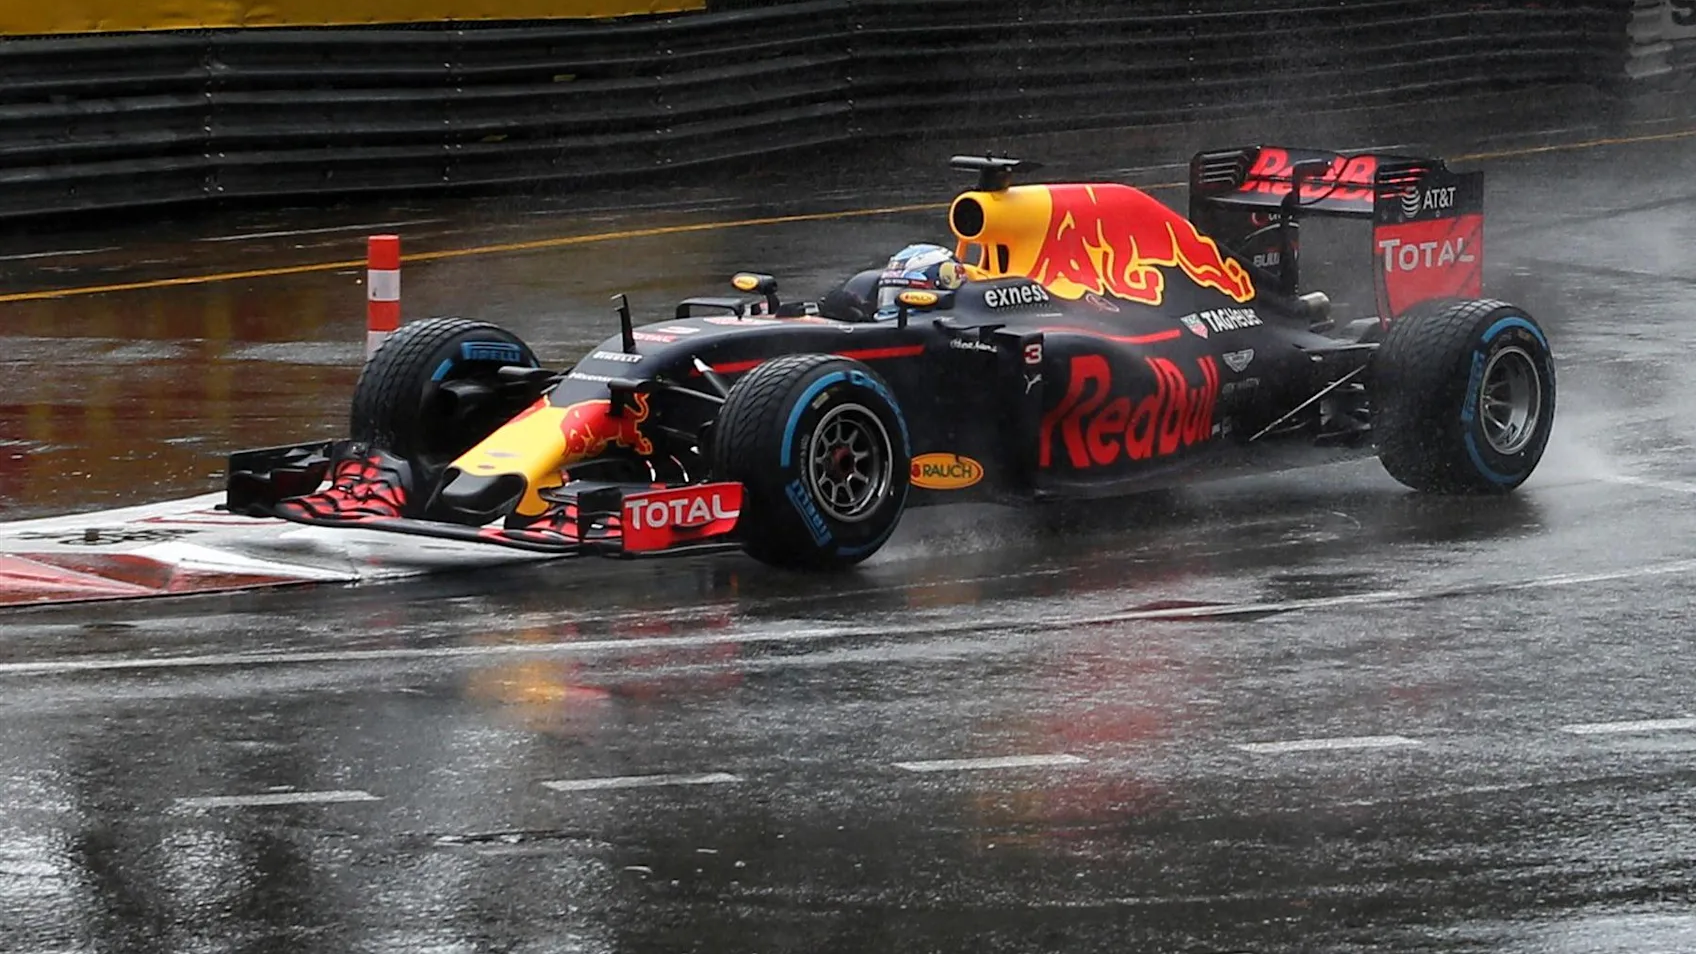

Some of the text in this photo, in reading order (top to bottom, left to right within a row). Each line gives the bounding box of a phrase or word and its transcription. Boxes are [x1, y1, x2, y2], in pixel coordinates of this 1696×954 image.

[1423, 186, 1457, 210] AT&T
[1378, 237, 1475, 273] TOTAL
[984, 284, 1050, 308] exness
[1024, 344, 1042, 364] 3
[922, 463, 972, 479] RAUCH
[624, 494, 741, 530] TOTAL
